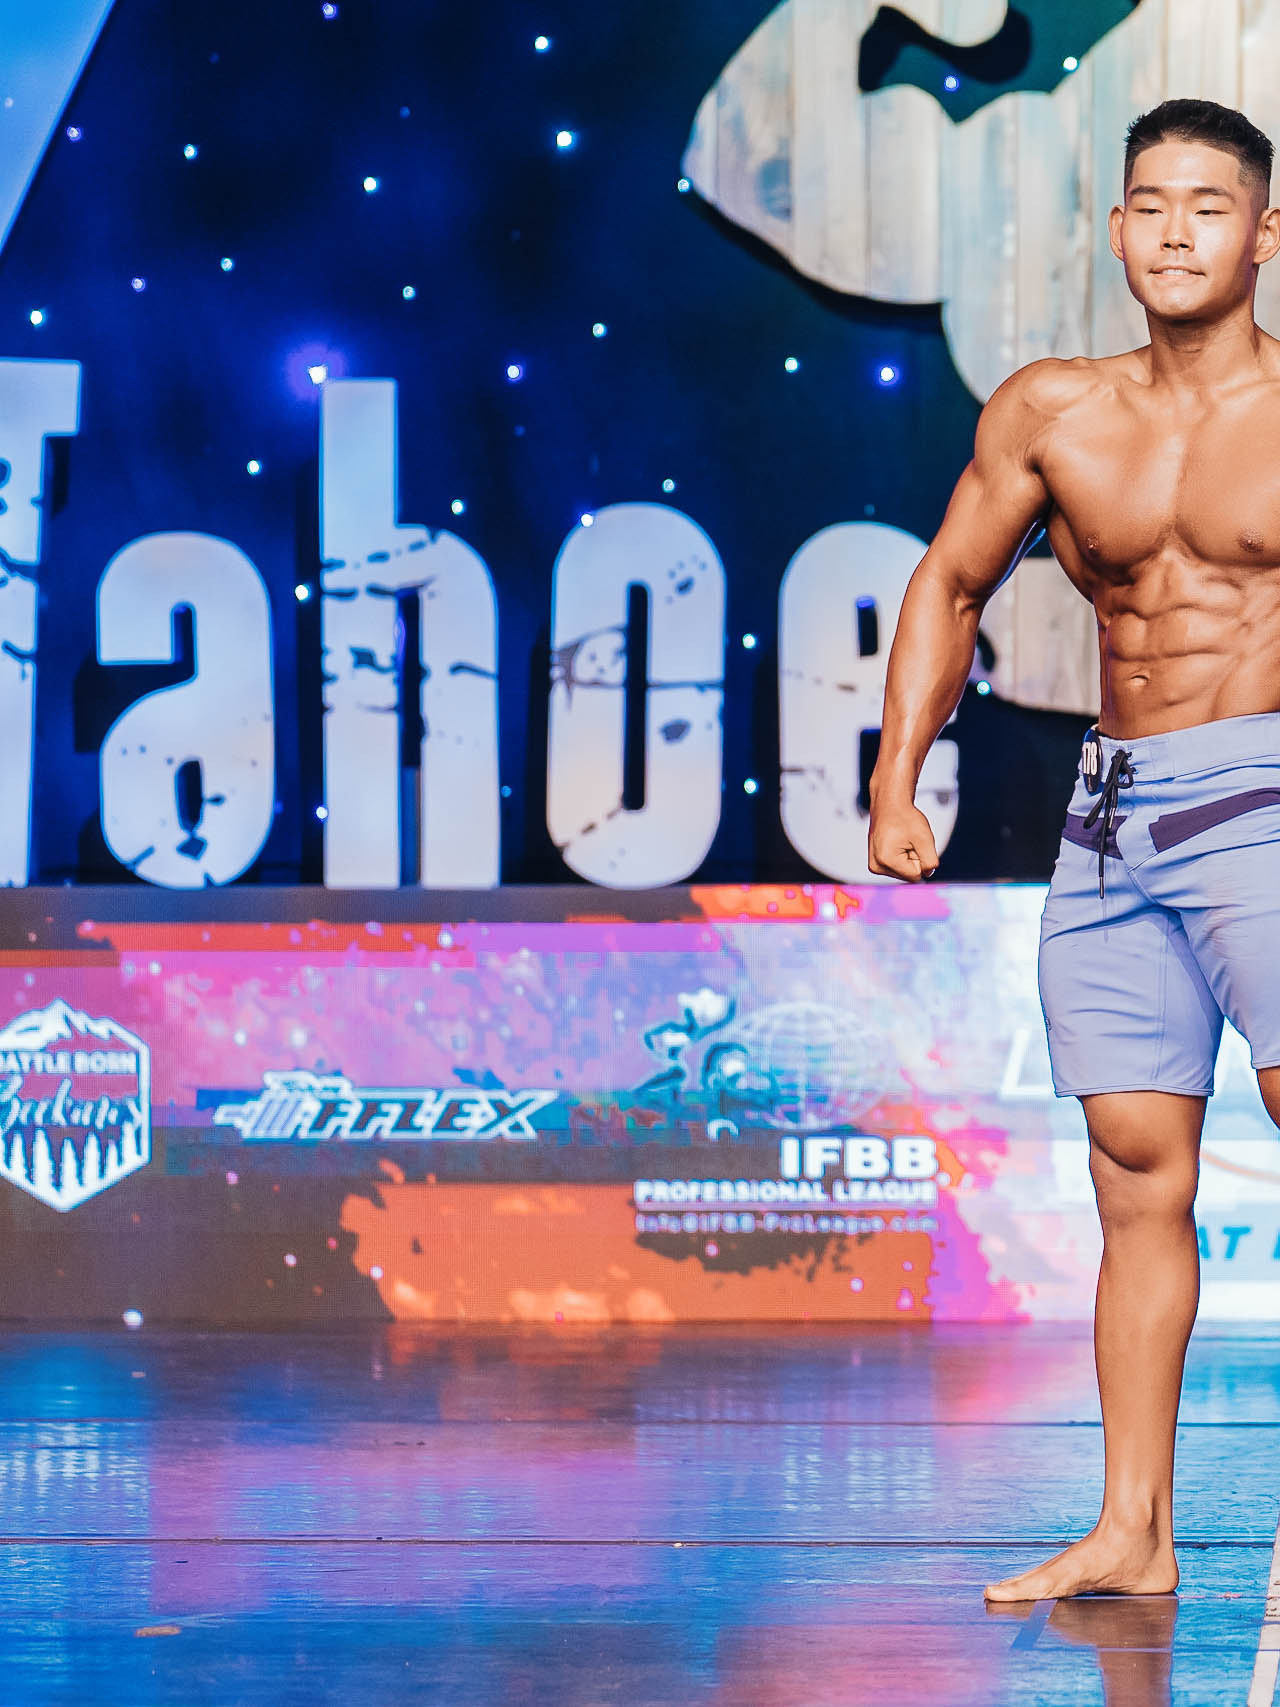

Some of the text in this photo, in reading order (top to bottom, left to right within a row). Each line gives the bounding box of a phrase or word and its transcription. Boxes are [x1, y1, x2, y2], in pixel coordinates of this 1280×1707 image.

[0, 1050, 71, 1074] ATTLE
[780, 1136, 938, 1179] IFBB
[634, 1179, 938, 1201] PROFESSIONAL LEAGUE
